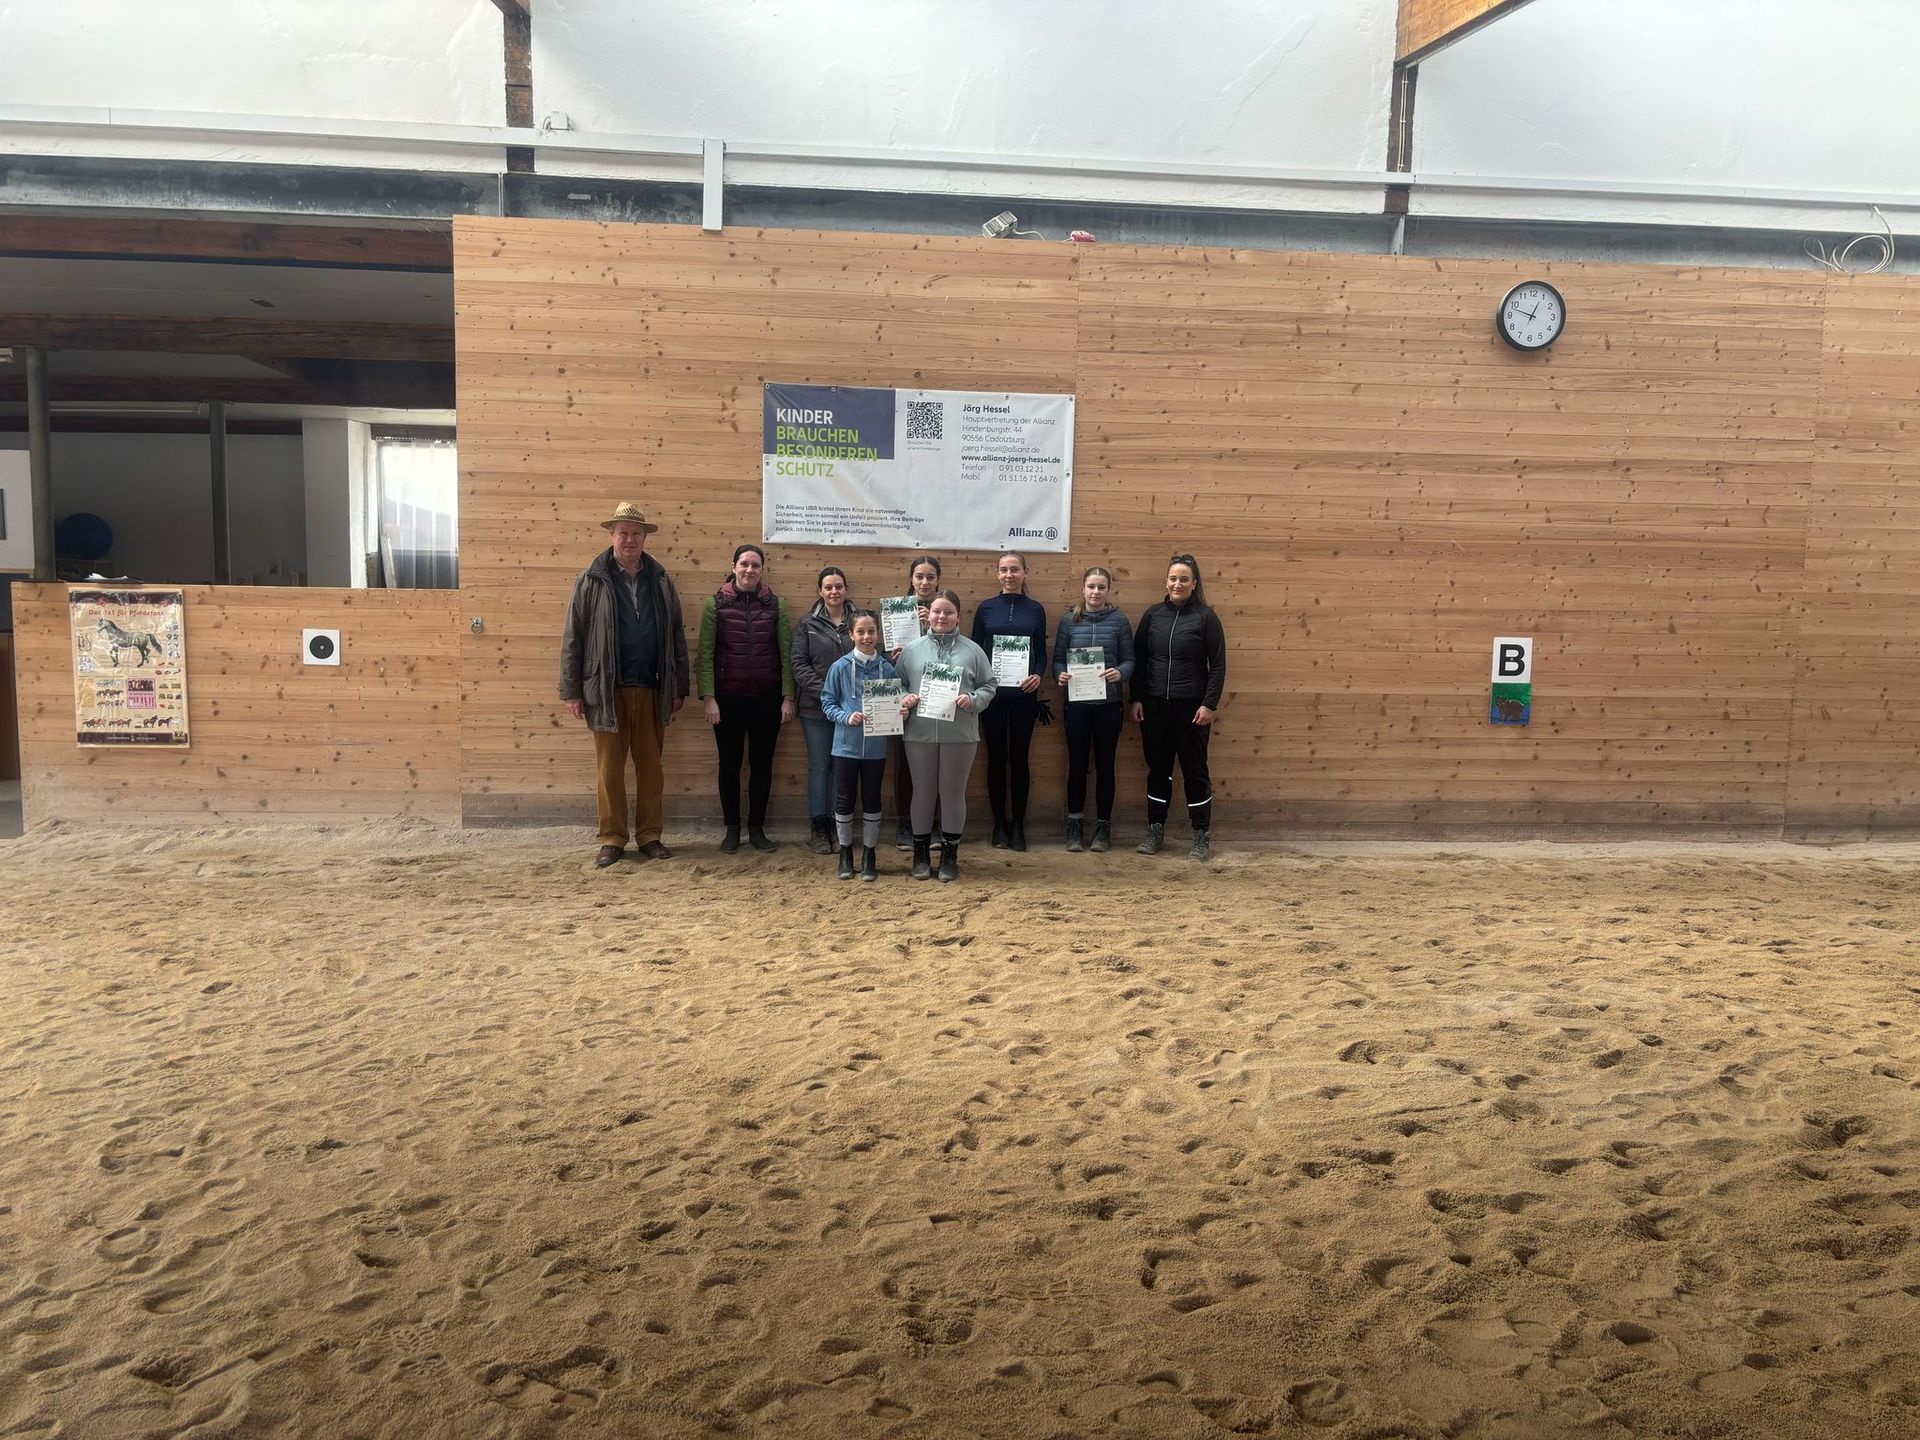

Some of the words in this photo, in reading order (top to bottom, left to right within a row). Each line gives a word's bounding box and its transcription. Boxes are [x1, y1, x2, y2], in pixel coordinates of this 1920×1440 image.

[1510, 322, 1514, 330] 8
[776, 408, 833, 424] KINDER
[962, 404, 980, 414] Jörg
[982, 404, 1010, 414] Hessel
[962, 415, 1018, 425] Hauptvertretung
[776, 426, 859, 443] BRAUCHEN
[962, 434, 984, 442] 90556
[984, 435, 1026, 444] Cadolzburg
[776, 444, 878, 463] BESONDEREN
[962, 454, 1061, 464] www.allianz-joerg-hessel.de
[776, 461, 834, 478] SCHUTZ
[1008, 528, 1043, 538] Allianz
[116, 609, 126, 617] für
[130, 610, 164, 618] Pferdefans
[883, 599, 894, 649] URKUNDE
[1498, 644, 1526, 676] B
[918, 661, 934, 714] URKUNDE
[864, 681, 875, 734] URKUNDE
